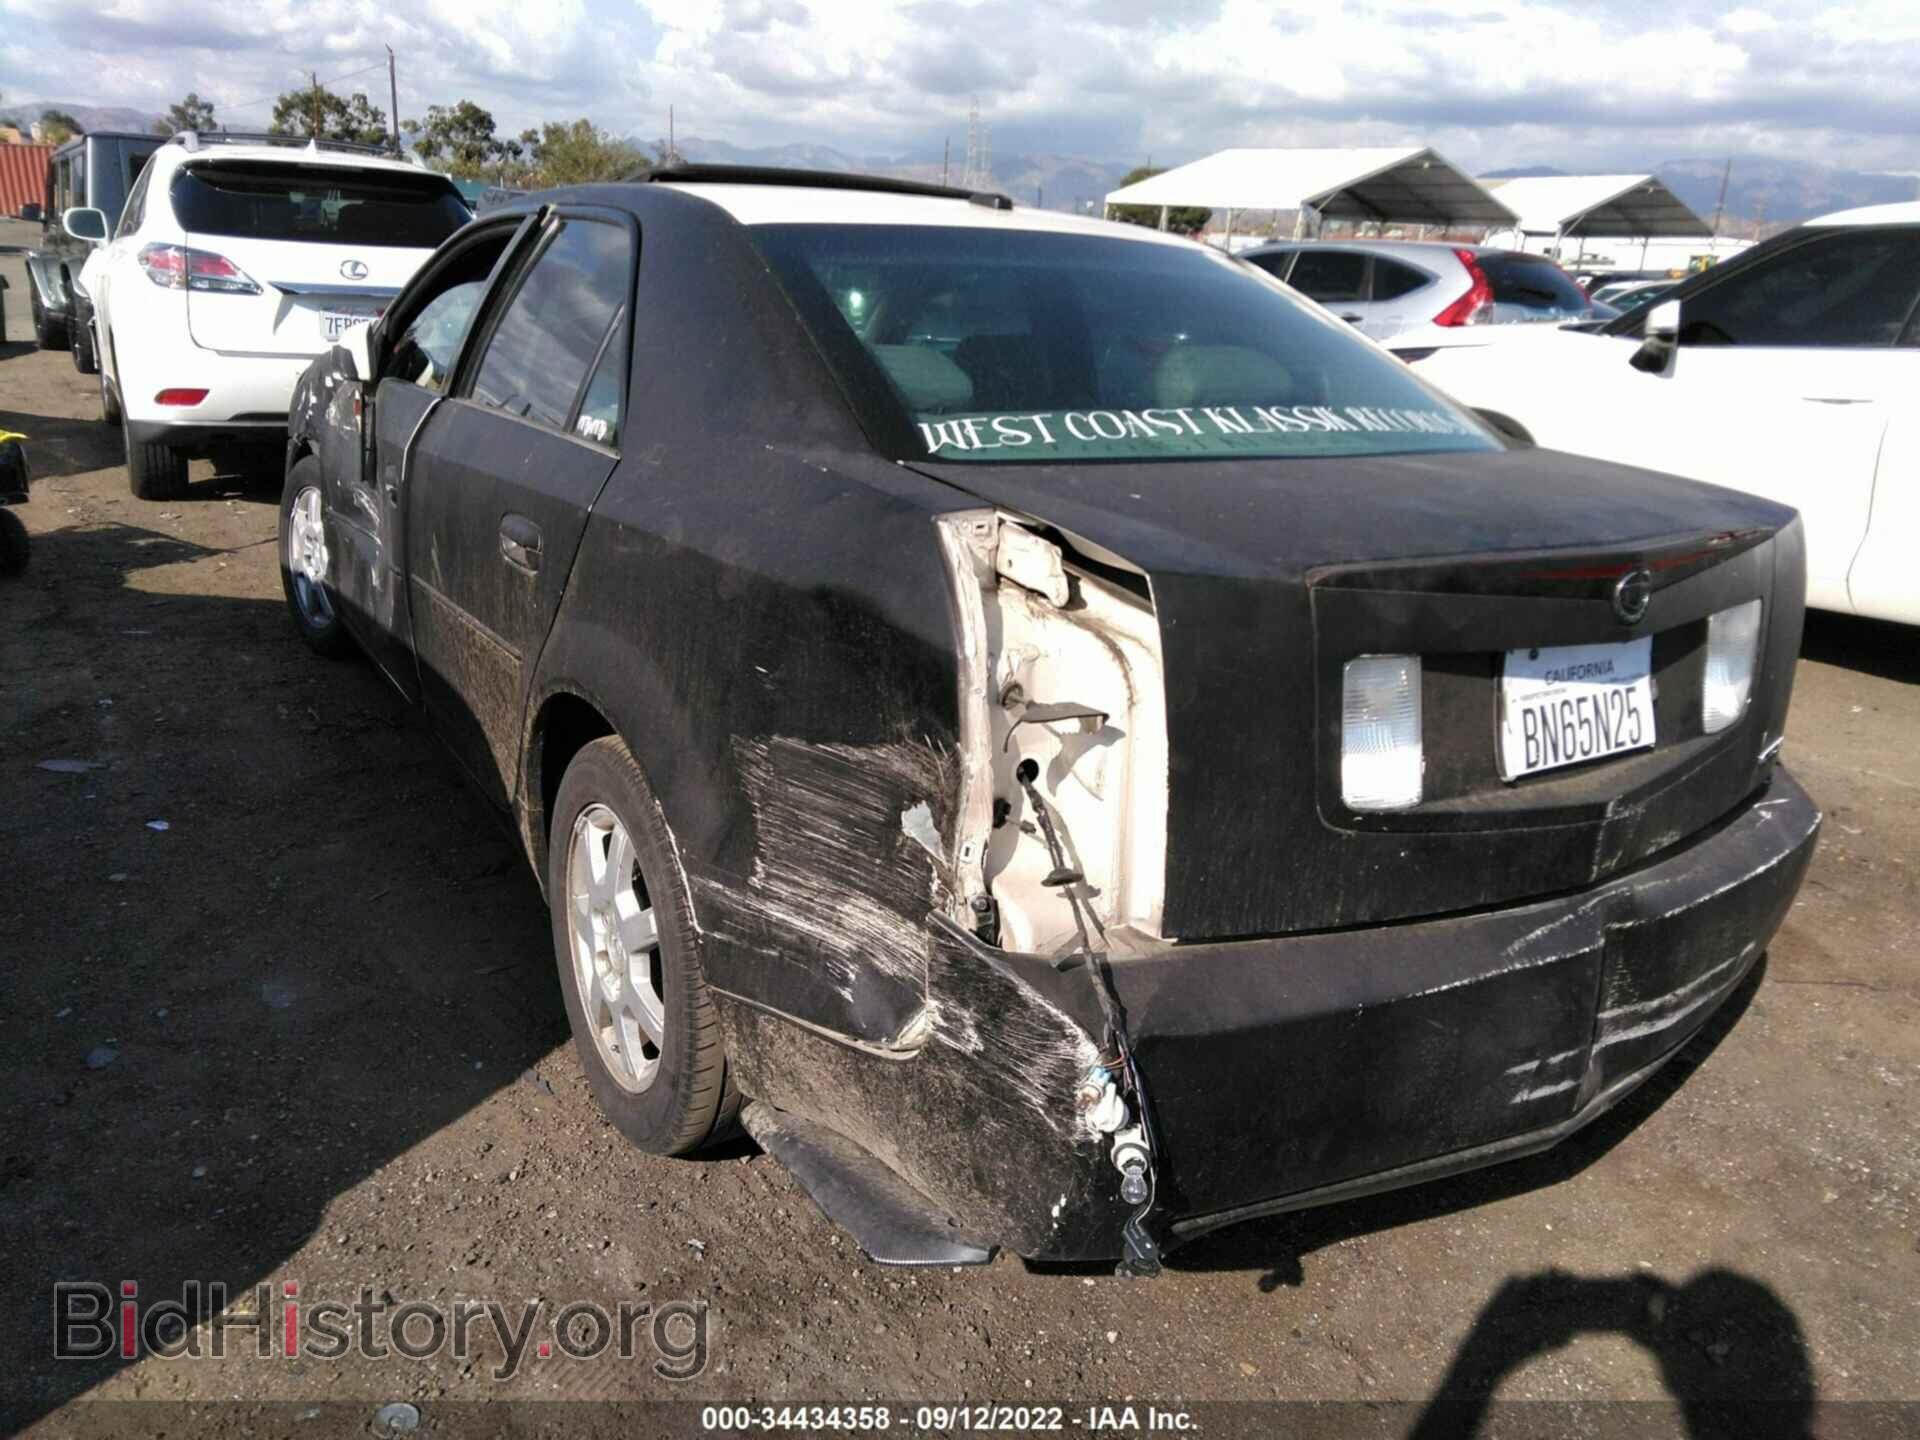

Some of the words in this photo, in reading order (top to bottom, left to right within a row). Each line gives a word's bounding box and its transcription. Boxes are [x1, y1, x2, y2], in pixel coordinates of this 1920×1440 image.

[918, 413, 1057, 453] WEST
[1064, 407, 1205, 441] COAST
[1203, 405, 1357, 434] KLASSIK
[1545, 659, 1615, 685] CALIFORNIA
[1522, 686, 1641, 769] BN65N25
